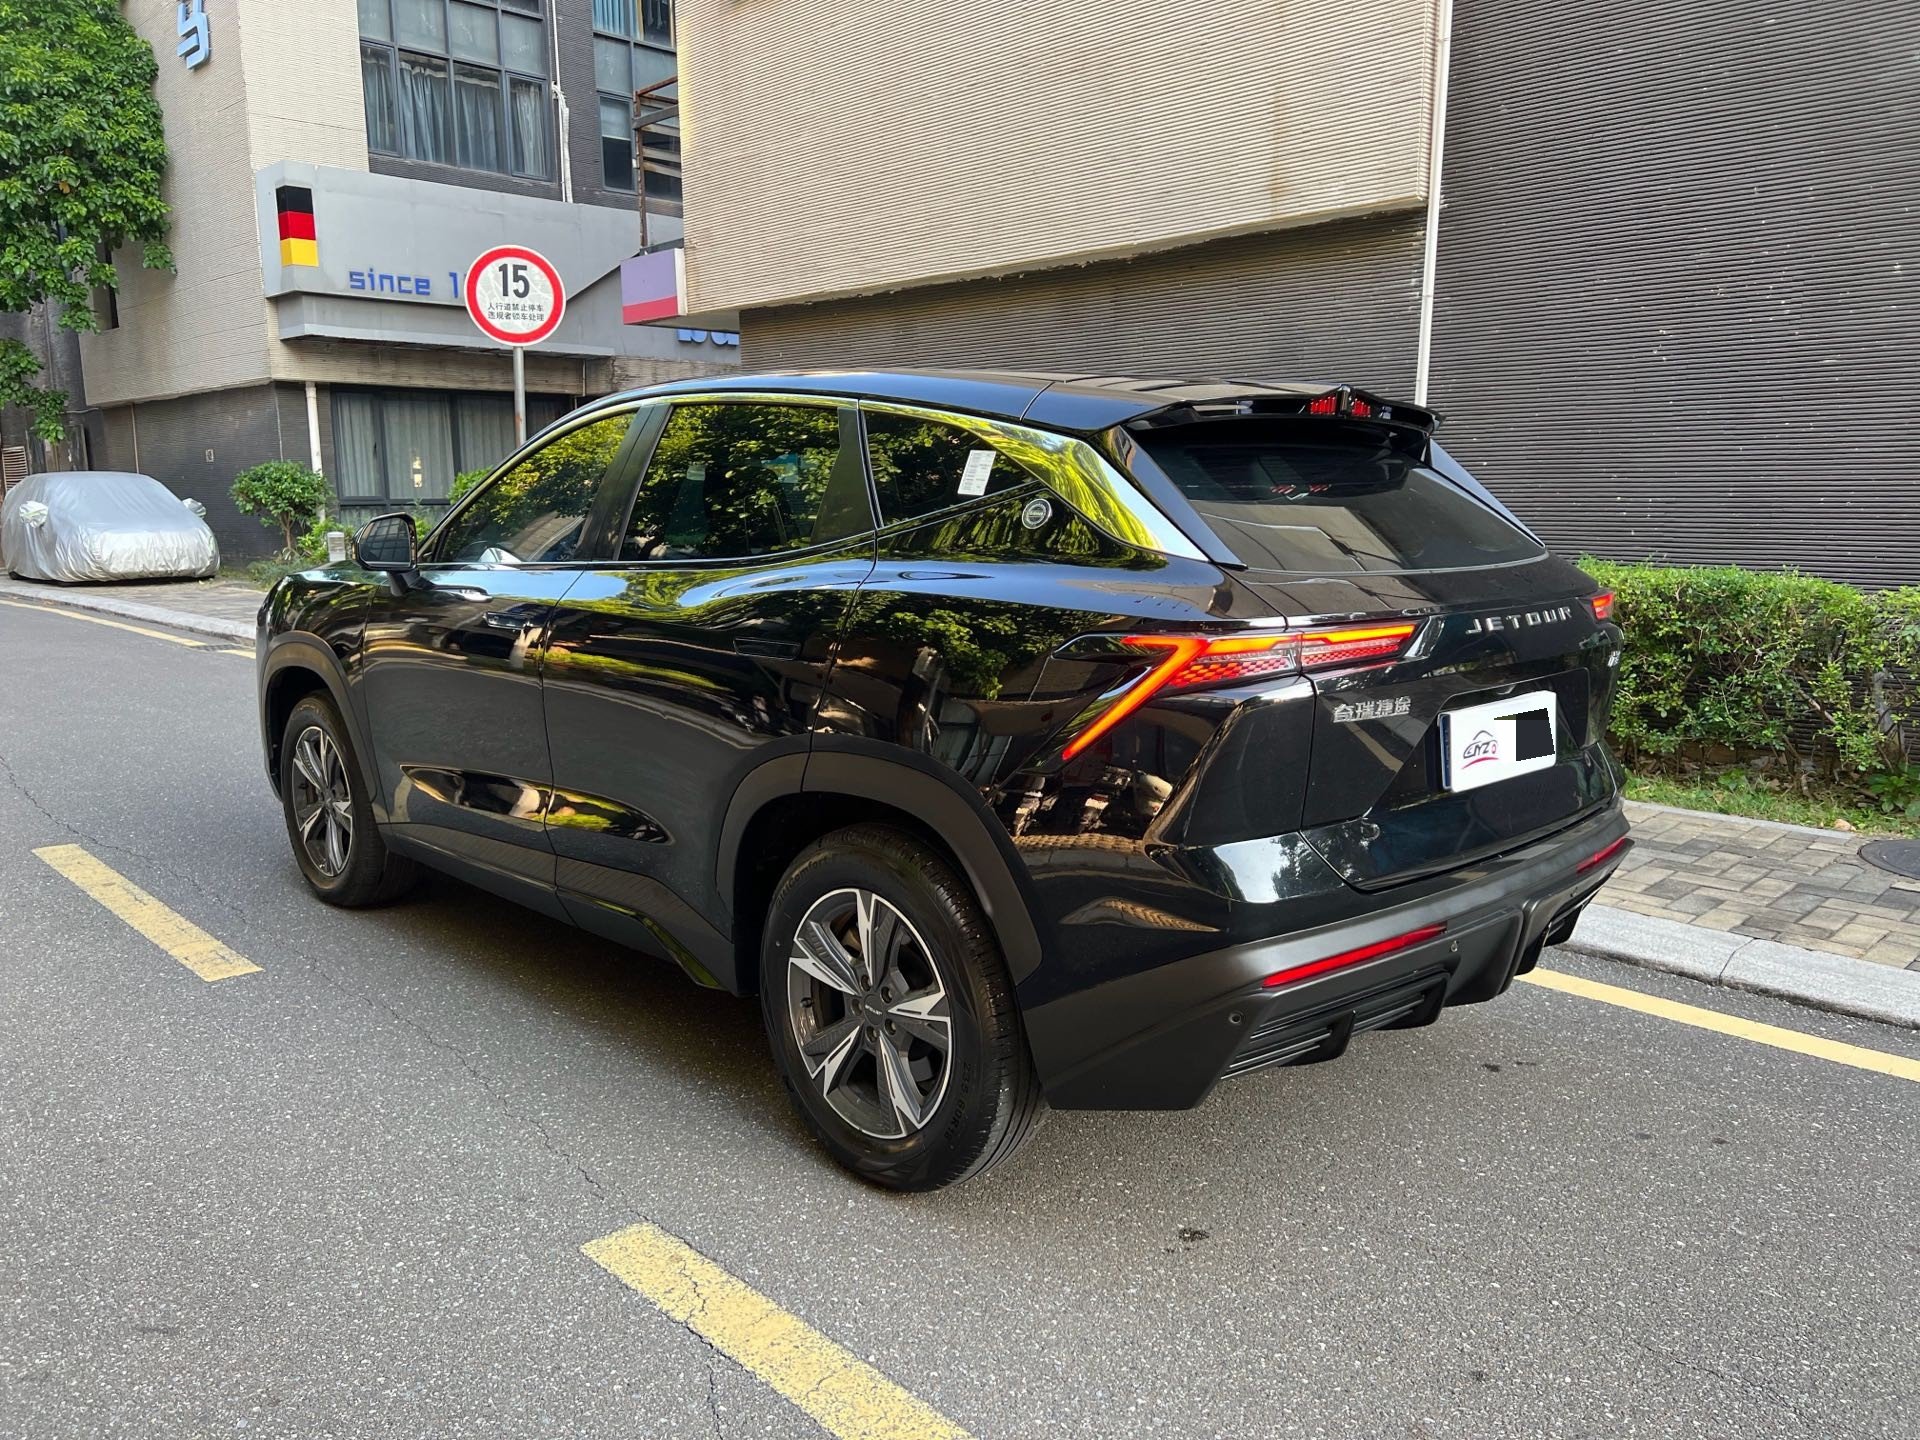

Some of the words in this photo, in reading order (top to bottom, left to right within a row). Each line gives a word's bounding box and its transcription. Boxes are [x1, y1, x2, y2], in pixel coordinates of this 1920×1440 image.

[349, 268, 431, 296] since
[449, 271, 463, 298] 1
[498, 263, 530, 299] 15
[488, 302, 544, 312] 人行道禁止停车
[1465, 606, 1572, 635] JETOUR
[1333, 696, 1411, 723] 奇瑞捷途
